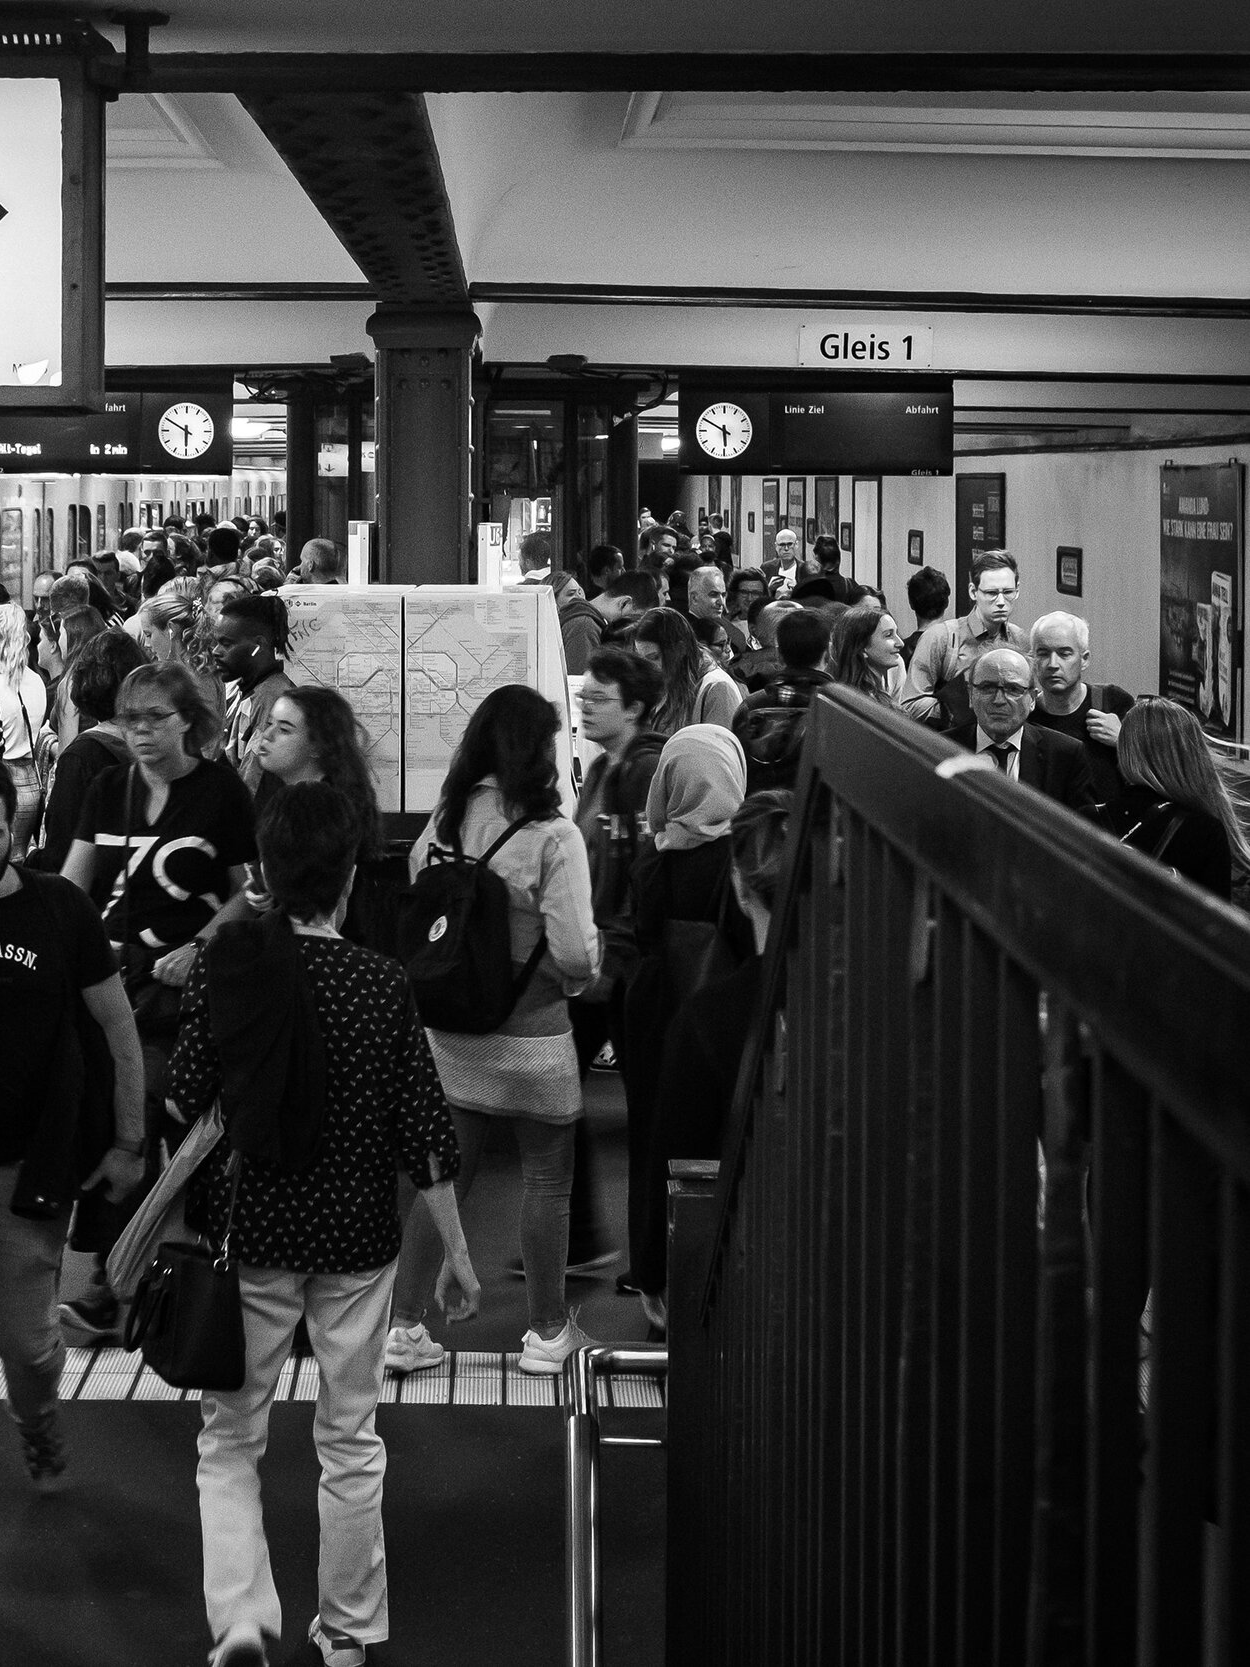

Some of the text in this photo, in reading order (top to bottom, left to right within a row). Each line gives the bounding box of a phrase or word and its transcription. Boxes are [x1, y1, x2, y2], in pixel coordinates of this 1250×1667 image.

[819, 332, 913, 361] Gleis 1
[784, 405, 825, 414] Linie Ziel
[905, 405, 939, 414] Abfahrt
[89, 443, 101, 455] in
